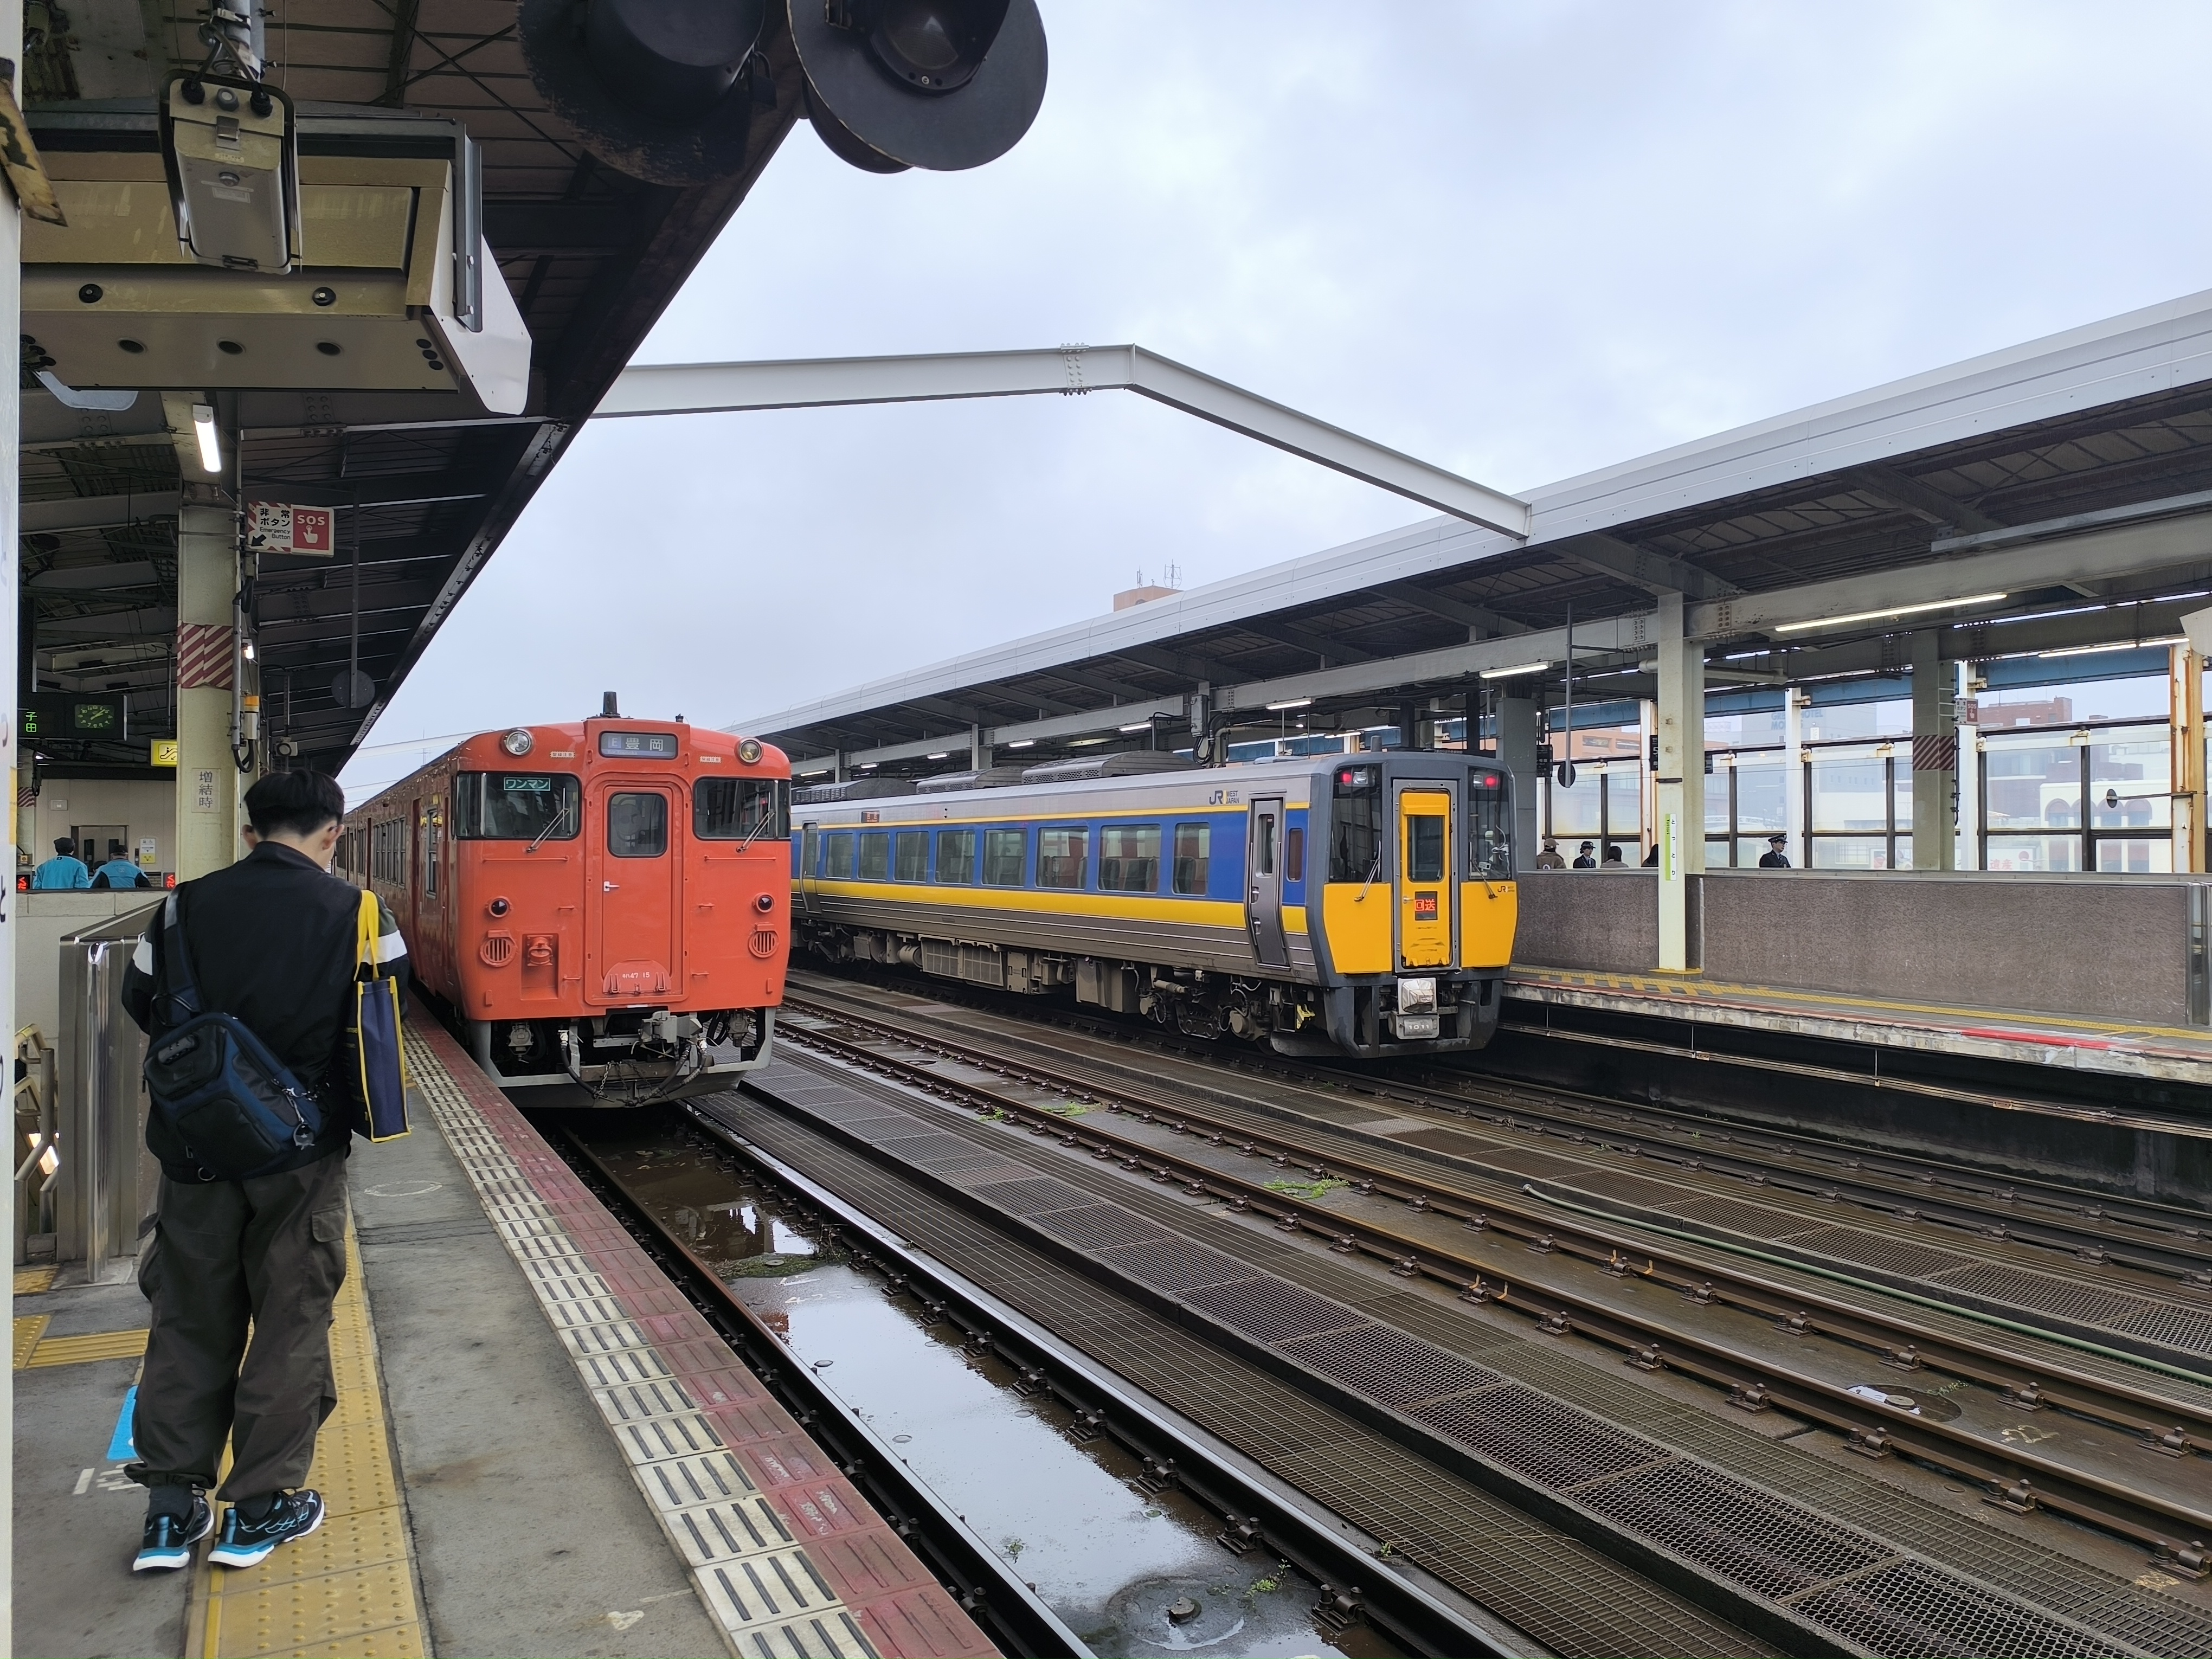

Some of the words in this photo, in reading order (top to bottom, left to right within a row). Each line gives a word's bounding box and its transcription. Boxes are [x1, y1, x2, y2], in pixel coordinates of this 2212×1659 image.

[260, 517, 290, 527] ボタン
[297, 515, 325, 526] SOS
[1771, 712, 1786, 721] GRE
[25, 723, 37, 732] 田
[611, 737, 618, 747] E
[506, 779, 549, 789] ワンマン
[198, 771, 213, 808] 増結時
[1209, 790, 1224, 805] JR
[1414, 898, 1436, 911] 回送
